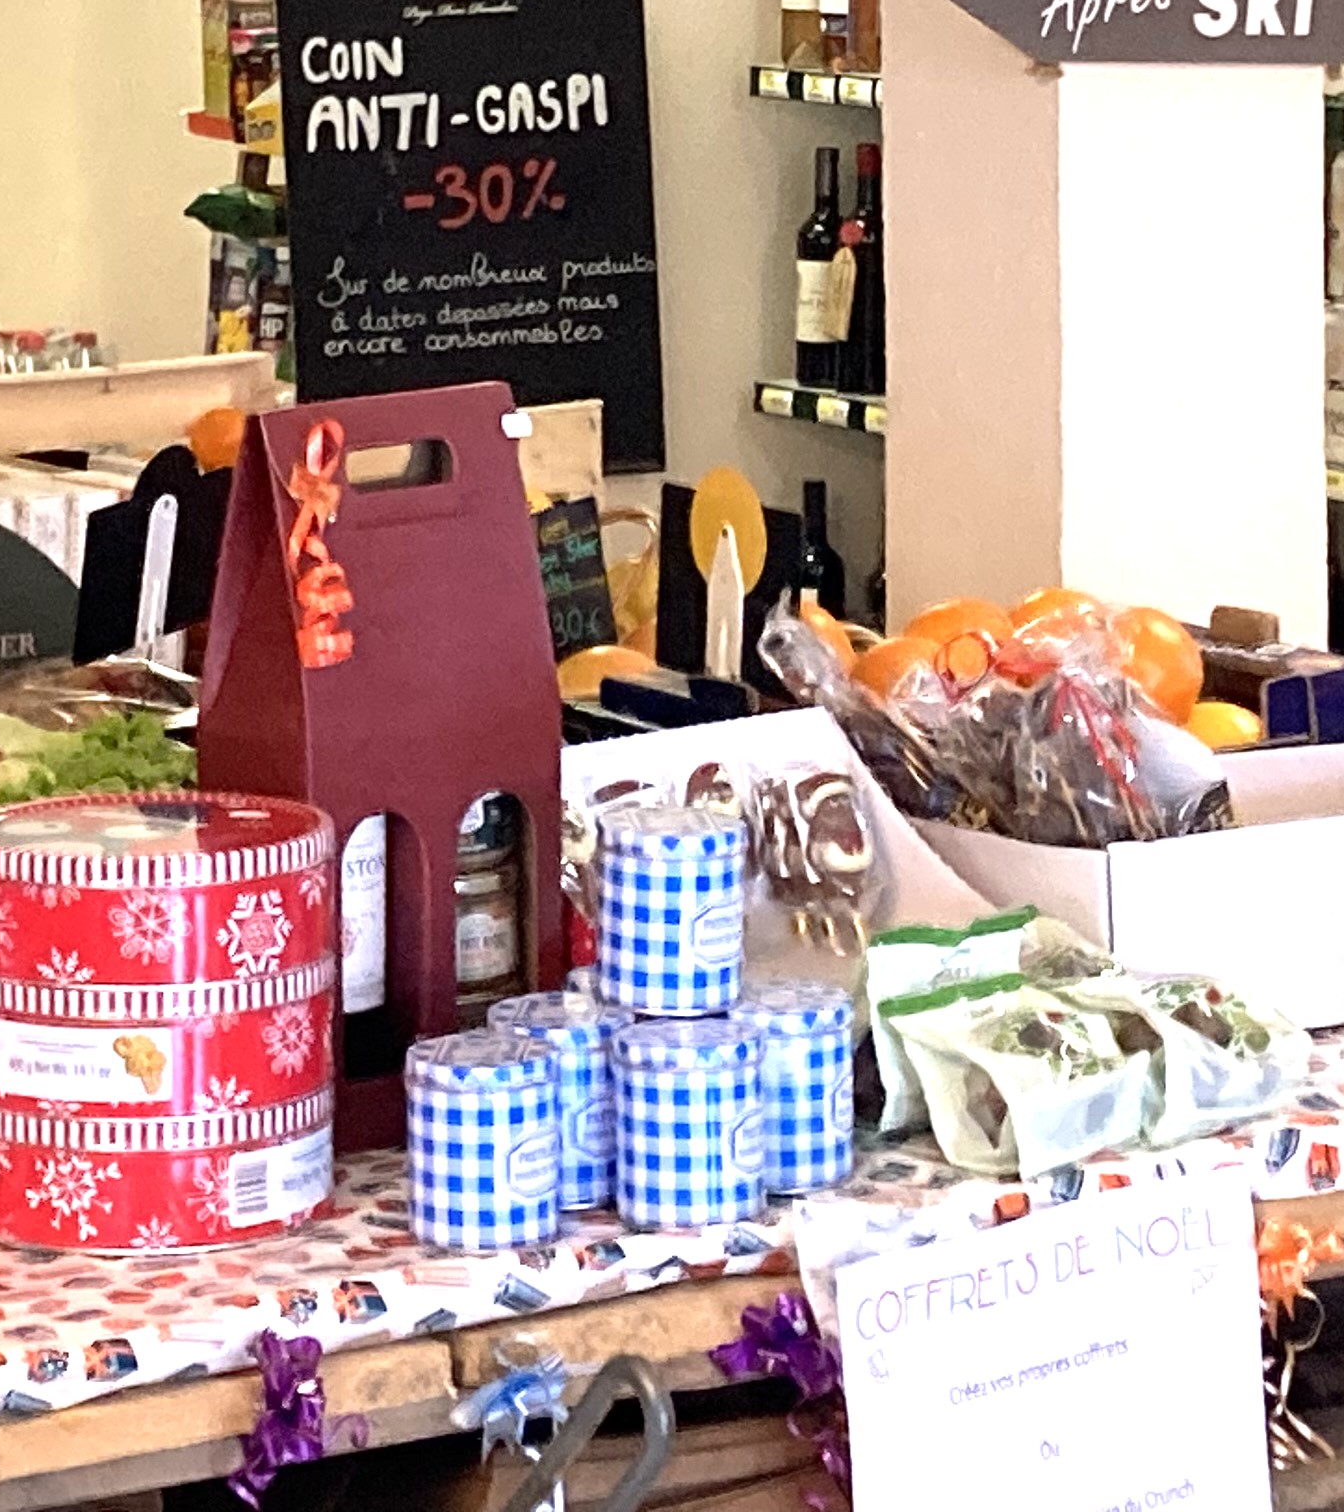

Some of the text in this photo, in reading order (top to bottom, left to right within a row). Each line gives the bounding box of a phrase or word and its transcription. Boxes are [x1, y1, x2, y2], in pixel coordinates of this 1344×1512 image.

[301, 35, 405, 85] COIN
[400, 156, 568, 230] -30%
[382, 267, 412, 294] de
[561, 251, 657, 289] produits
[358, 305, 428, 331] dates
[558, 294, 620, 311] mais
[324, 335, 408, 359] encore
[855, 1251, 1040, 1341] COFFRETS
[1055, 1234, 1096, 1284] DE
